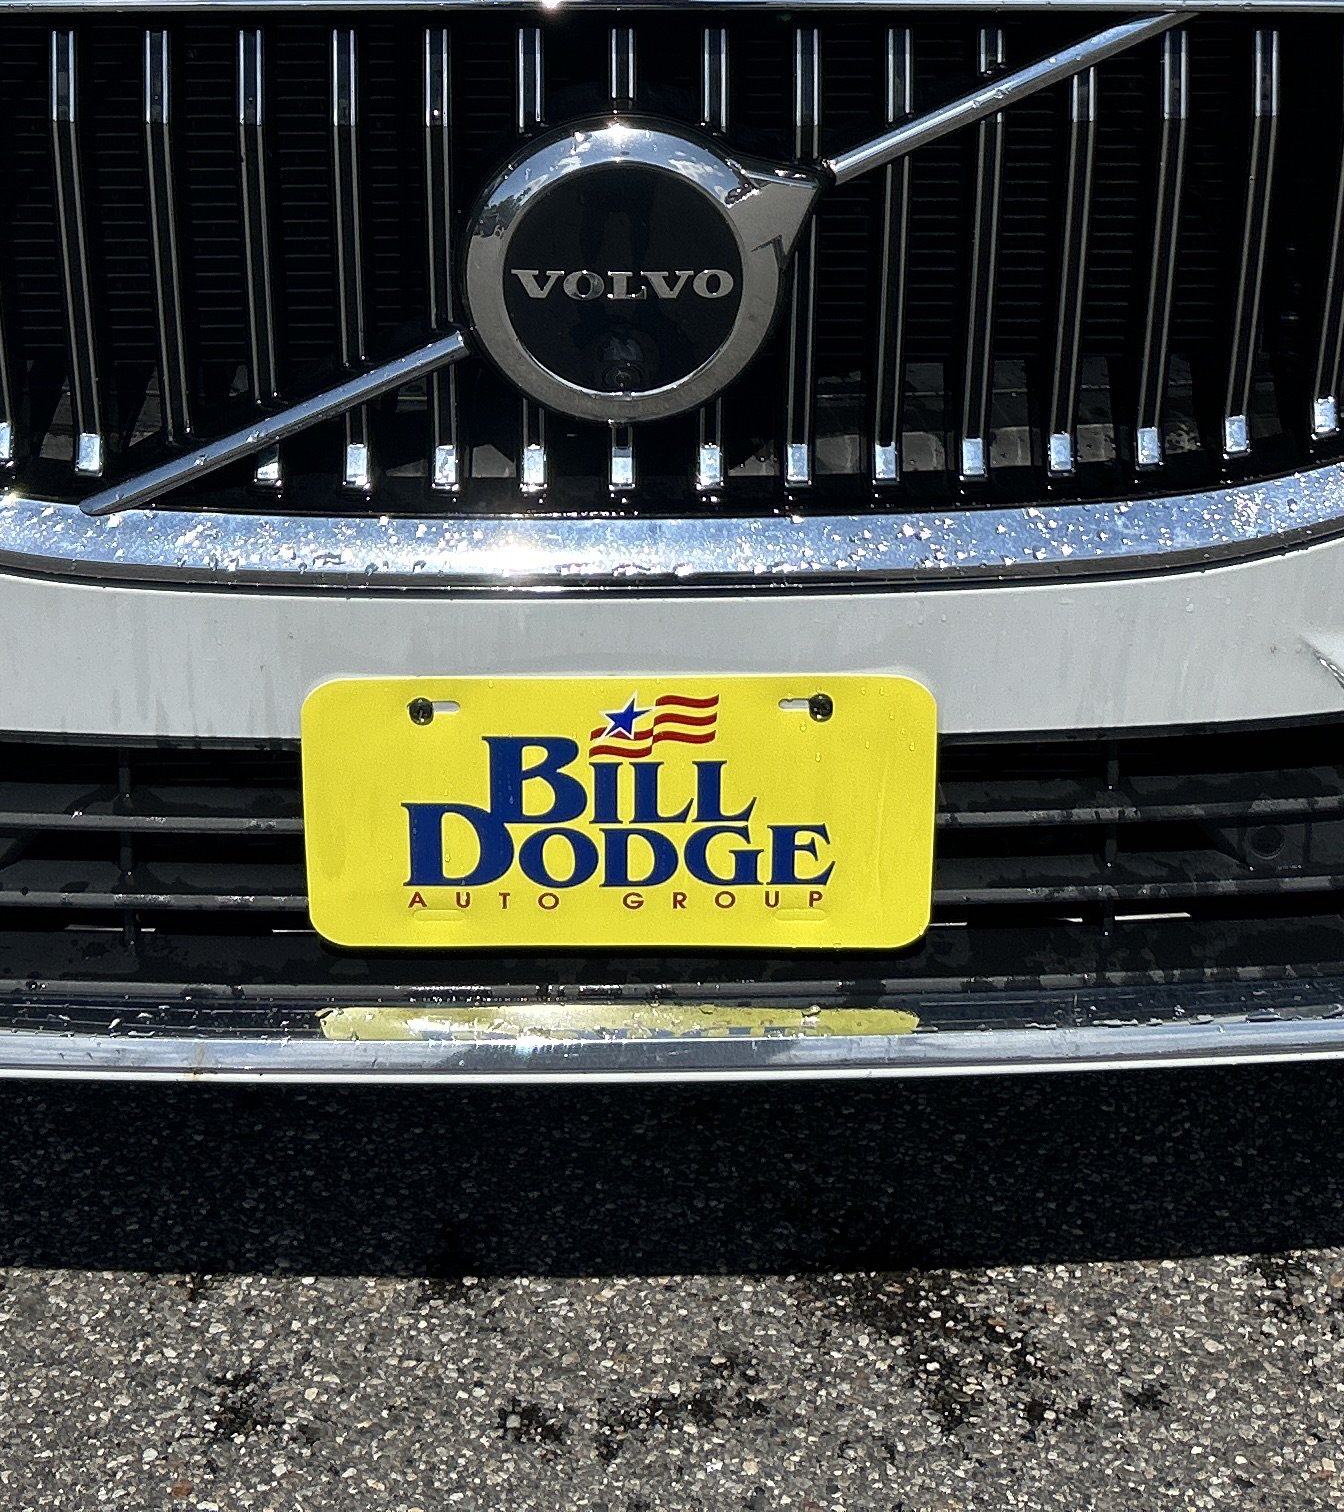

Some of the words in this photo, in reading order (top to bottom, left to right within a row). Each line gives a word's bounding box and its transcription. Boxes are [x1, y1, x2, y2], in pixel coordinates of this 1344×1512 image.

[511, 269, 735, 301] VOLVO
[481, 735, 758, 825] BILL
[401, 802, 837, 889] DODGE
[407, 891, 560, 910] AUTO
[622, 890, 824, 910] GROUP
